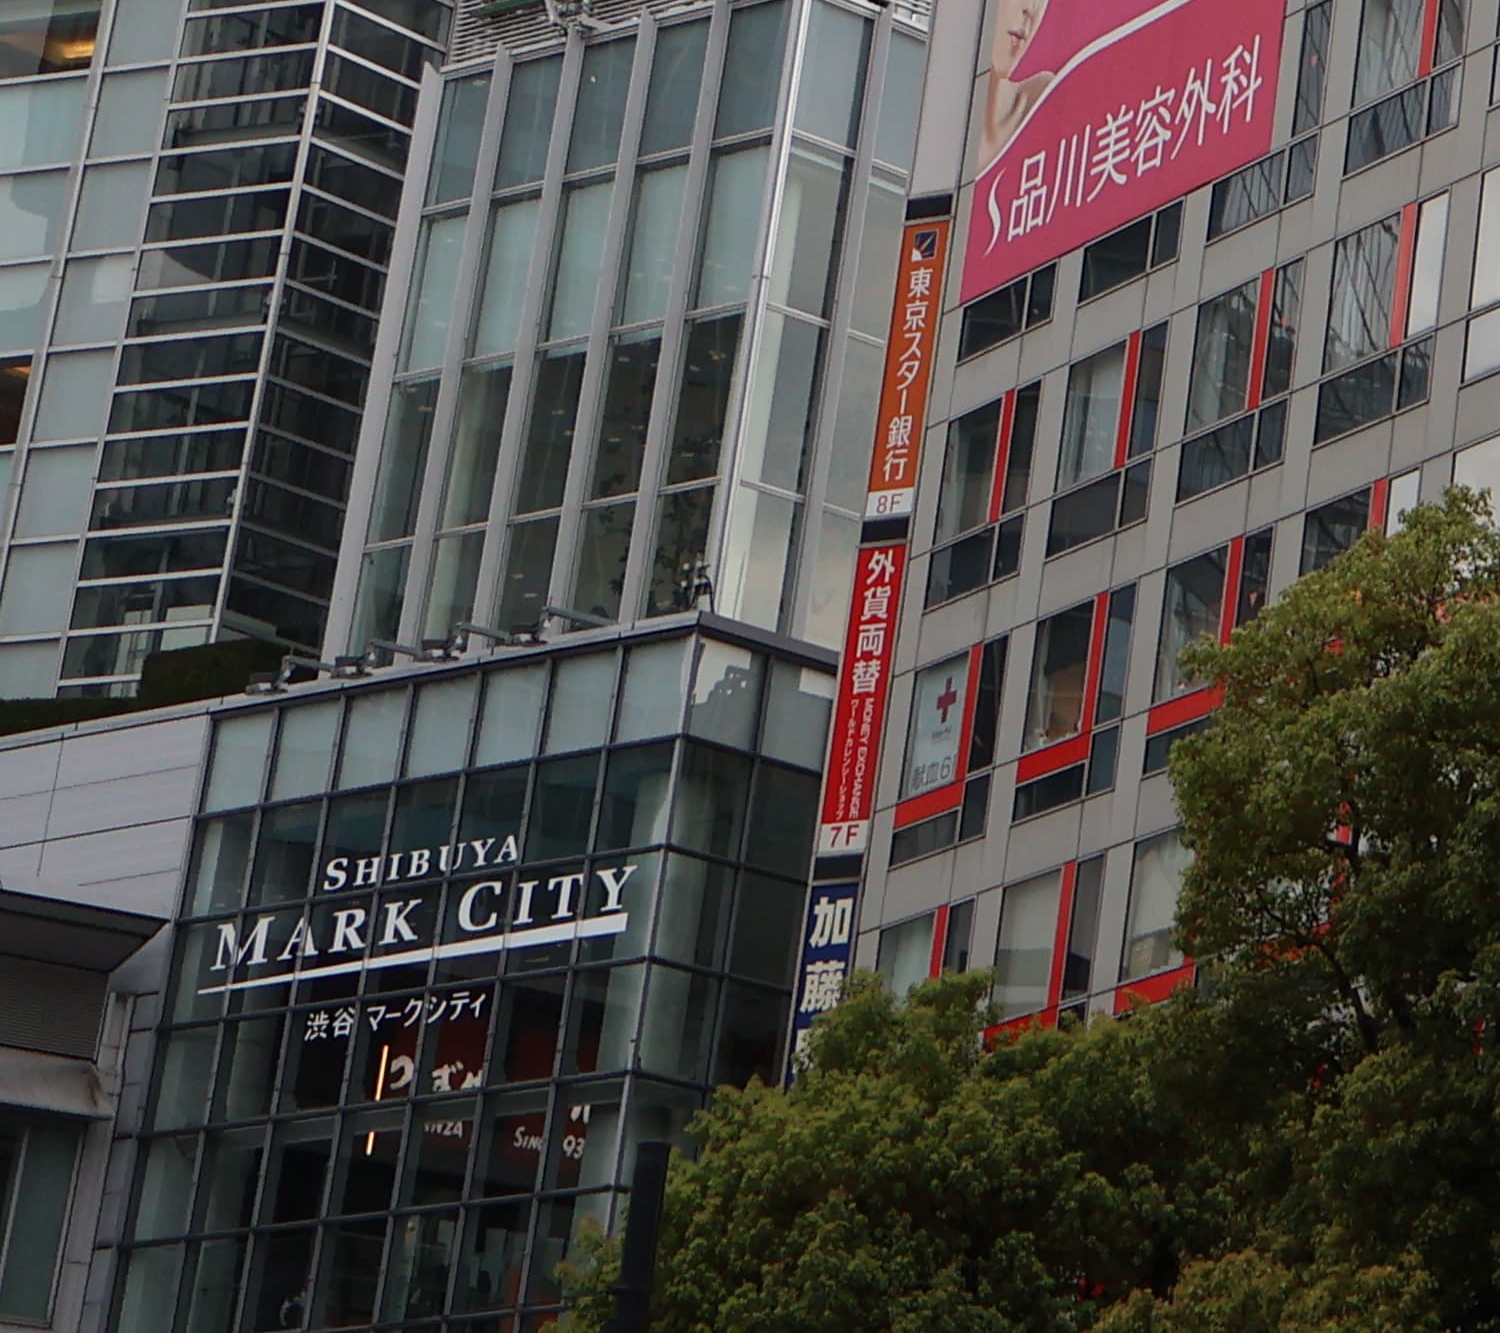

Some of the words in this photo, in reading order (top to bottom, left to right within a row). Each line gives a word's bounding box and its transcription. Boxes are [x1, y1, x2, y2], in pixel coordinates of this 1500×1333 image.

[1007, 34, 1262, 243] 品川美容外科
[883, 267, 934, 483] 東京スター銀行
[876, 493, 904, 514] 8F
[852, 550, 896, 695] 外貨両替
[323, 834, 520, 892] SHIBUYA
[830, 824, 860, 849] 7F
[210, 898, 423, 971] MARK
[457, 865, 638, 932] CITY
[304, 1007, 355, 1041] 渋谷
[367, 991, 486, 1032] マークシティ
